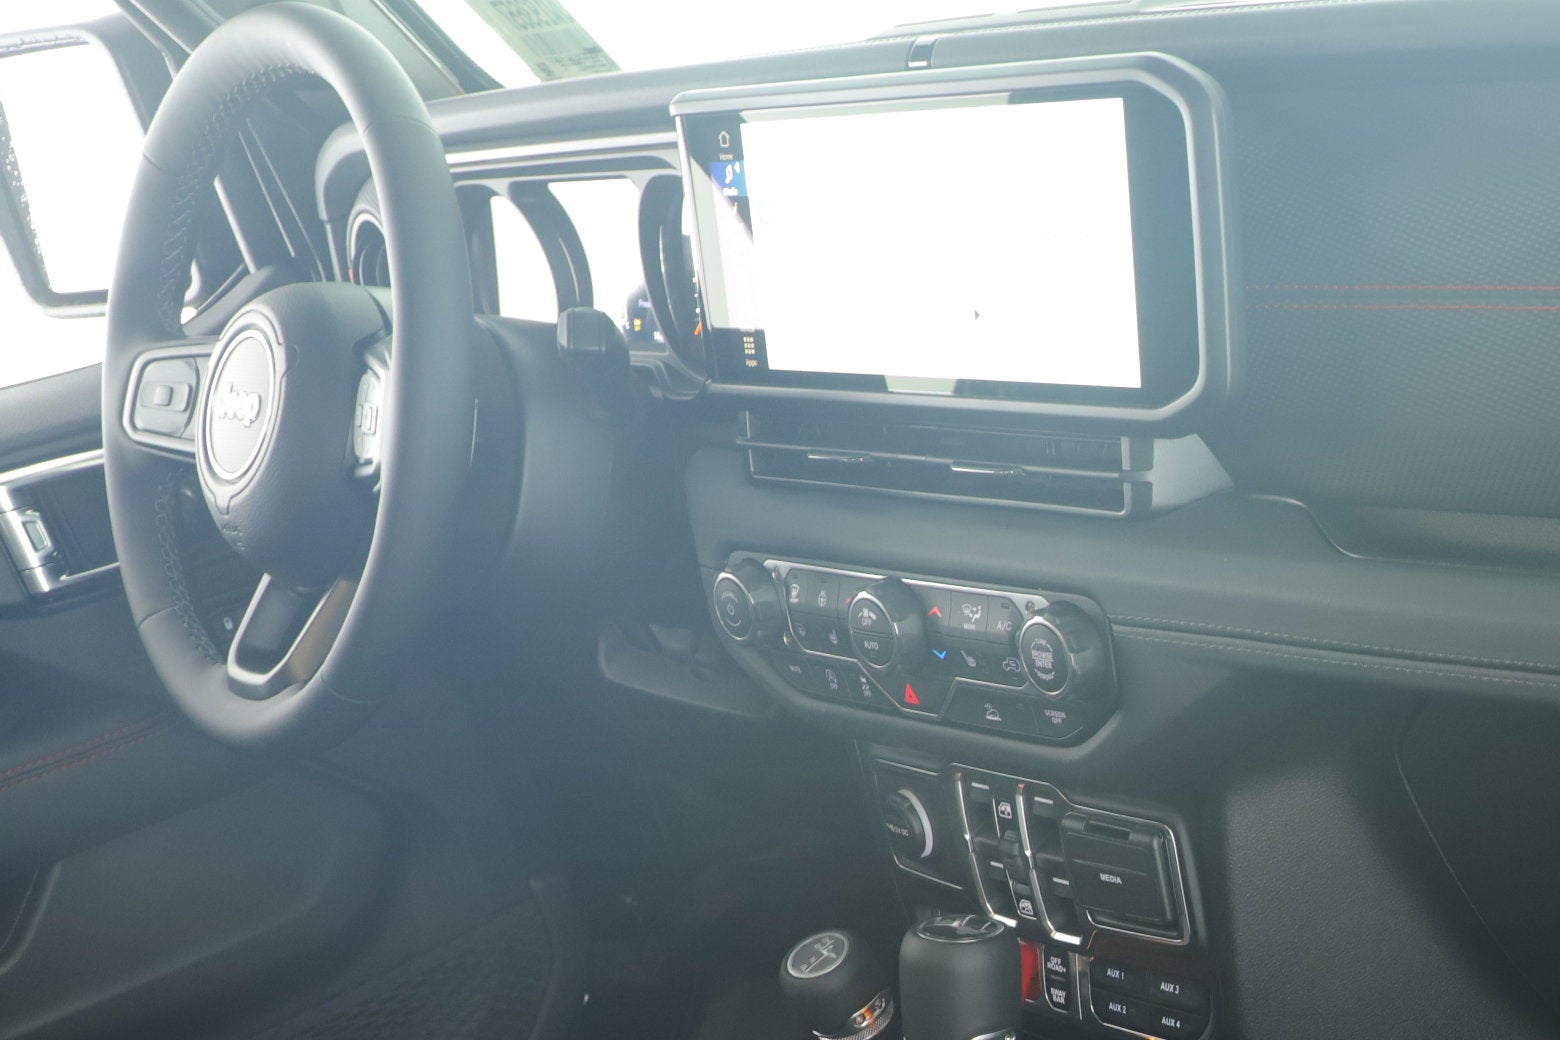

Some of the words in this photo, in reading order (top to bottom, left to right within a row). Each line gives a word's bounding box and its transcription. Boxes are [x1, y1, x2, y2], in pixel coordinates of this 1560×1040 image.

[861, 618, 873, 627] OFF
[996, 620, 1013, 632] A/C
[864, 641, 879, 651] AUTO
[1035, 660, 1052, 669] ENTER
[1044, 709, 1066, 719] SCREEN
[1100, 872, 1122, 885] MEDIA
[1050, 956, 1062, 965] OFF
[1106, 967, 1120, 979] AUX
[1121, 972, 1125, 981] 1
[1050, 987, 1066, 998] SWAY
[1160, 981, 1174, 993] AUX
[1174, 985, 1180, 995] 3
[1052, 994, 1066, 1005] BAR
[1108, 1002, 1122, 1013] AUX
[1122, 1006, 1127, 1015] 2
[1161, 1016, 1175, 1027] AUX
[1176, 1020, 1181, 1029] 4
